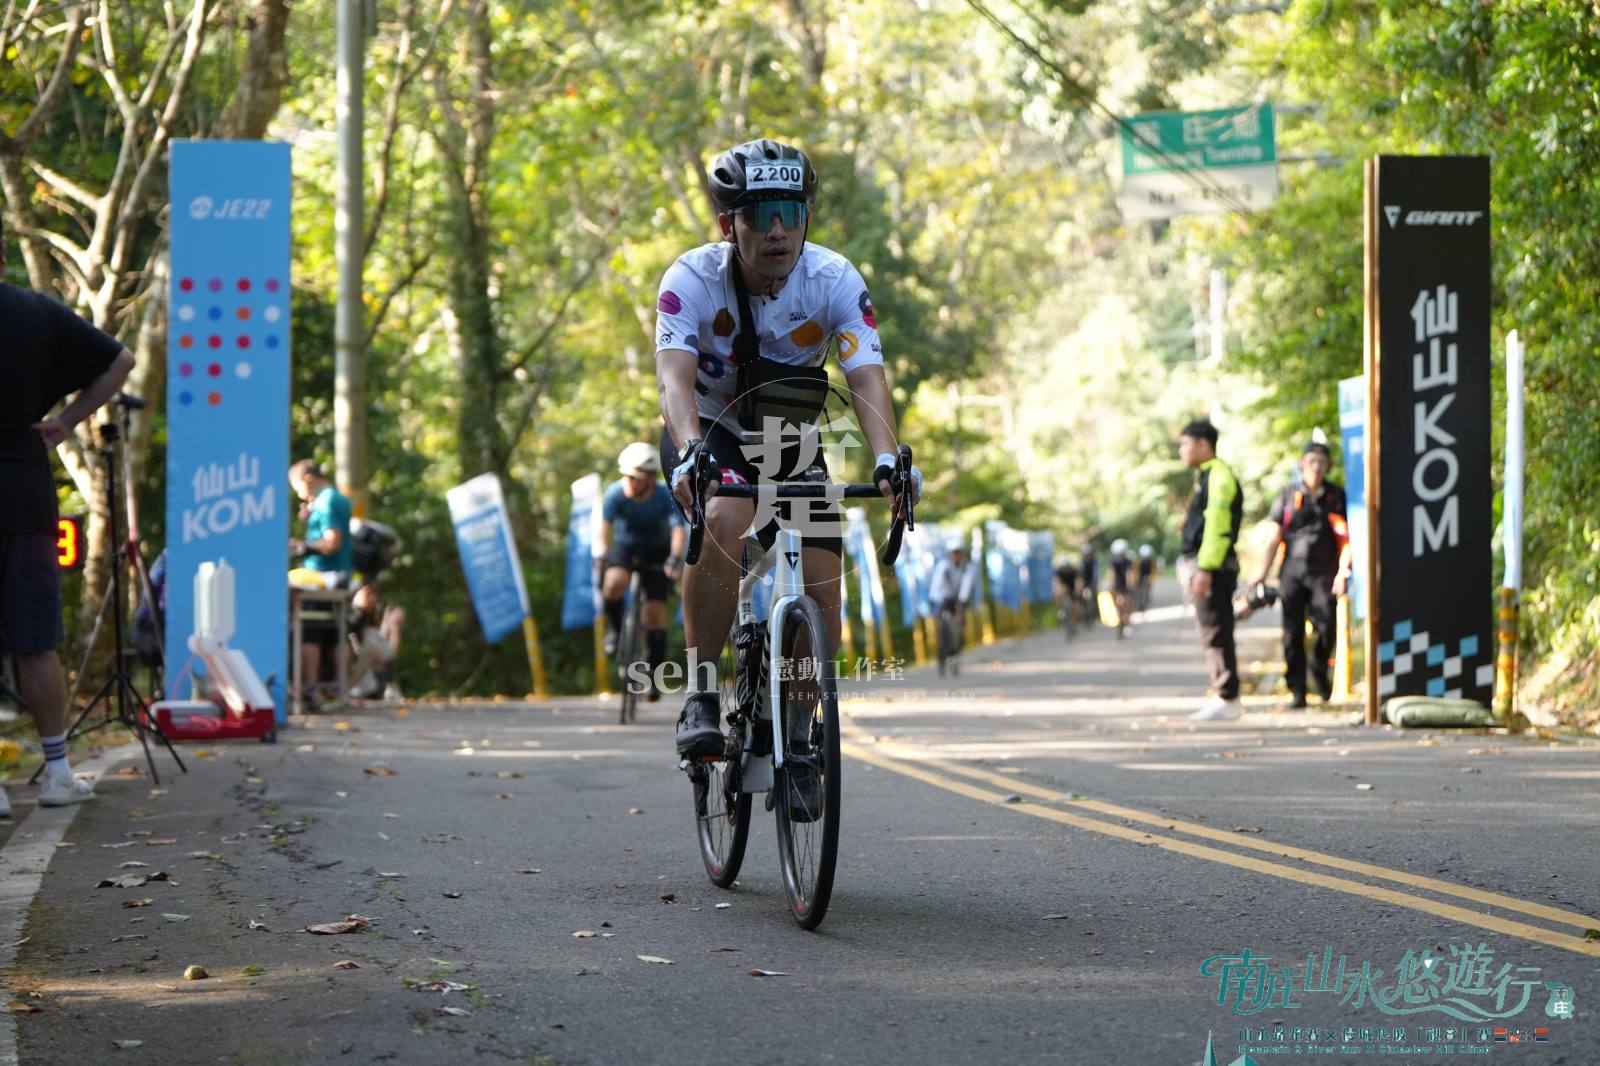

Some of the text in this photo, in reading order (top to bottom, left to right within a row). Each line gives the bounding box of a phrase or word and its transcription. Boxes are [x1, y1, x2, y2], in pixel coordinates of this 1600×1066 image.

[1405, 210, 1482, 226] GIANT
[1410, 284, 1460, 558] 仙山 KOM
[192, 452, 259, 503] 仙山
[183, 486, 276, 544] KOM
